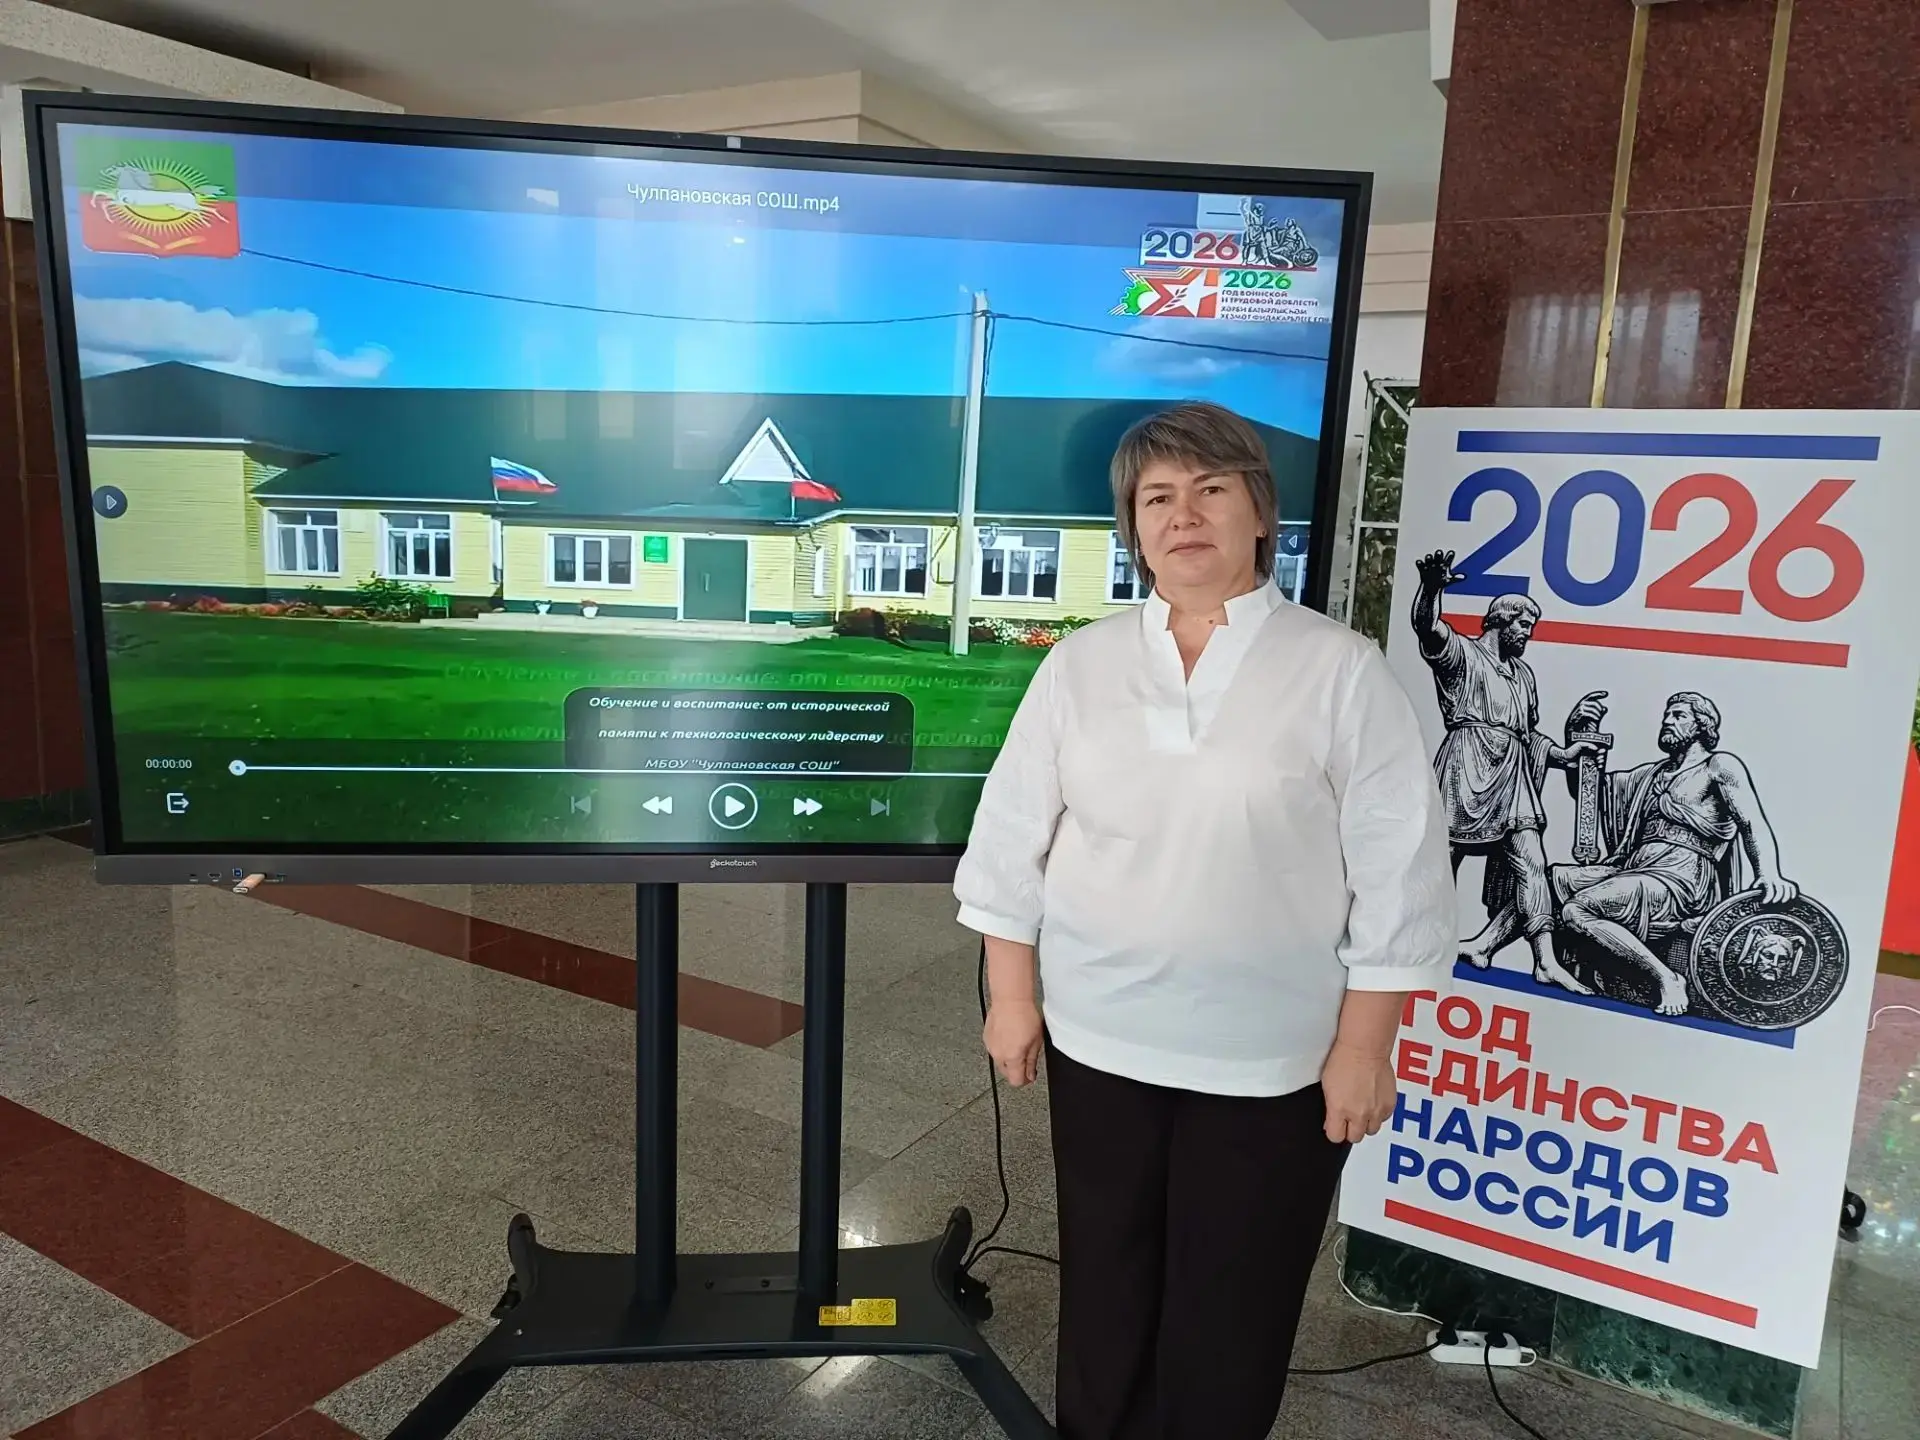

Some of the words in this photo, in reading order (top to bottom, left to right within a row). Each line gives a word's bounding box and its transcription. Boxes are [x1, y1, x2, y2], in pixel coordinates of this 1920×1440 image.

[627, 183, 751, 206] Чулпановская
[757, 191, 840, 214] СОШ.mp4
[1145, 229, 1239, 260] 2026
[1224, 270, 1291, 289] 2026
[1443, 467, 1865, 622] 2026
[589, 696, 658, 709] Обучение
[661, 700, 670, 708] и
[673, 700, 764, 710] воспитание:
[766, 701, 788, 710] от
[791, 701, 890, 712] исторической
[598, 729, 657, 739] памяти
[660, 730, 669, 738] к
[671, 731, 806, 742] технологическому
[808, 731, 884, 743] лидерству
[145, 758, 193, 769] 00:00:00
[645, 759, 688, 769] МБОУ
[692, 759, 796, 771] "Чулпановская
[799, 760, 840, 771] СОШ"
[709, 858, 757, 869] geckotouch
[1401, 989, 1532, 1063] ГОД
[1396, 1038, 1779, 1175] ЕДИНСТВА
[1391, 1091, 1730, 1218] НАРОДОВ
[1387, 1143, 1674, 1264] РОССИИ
